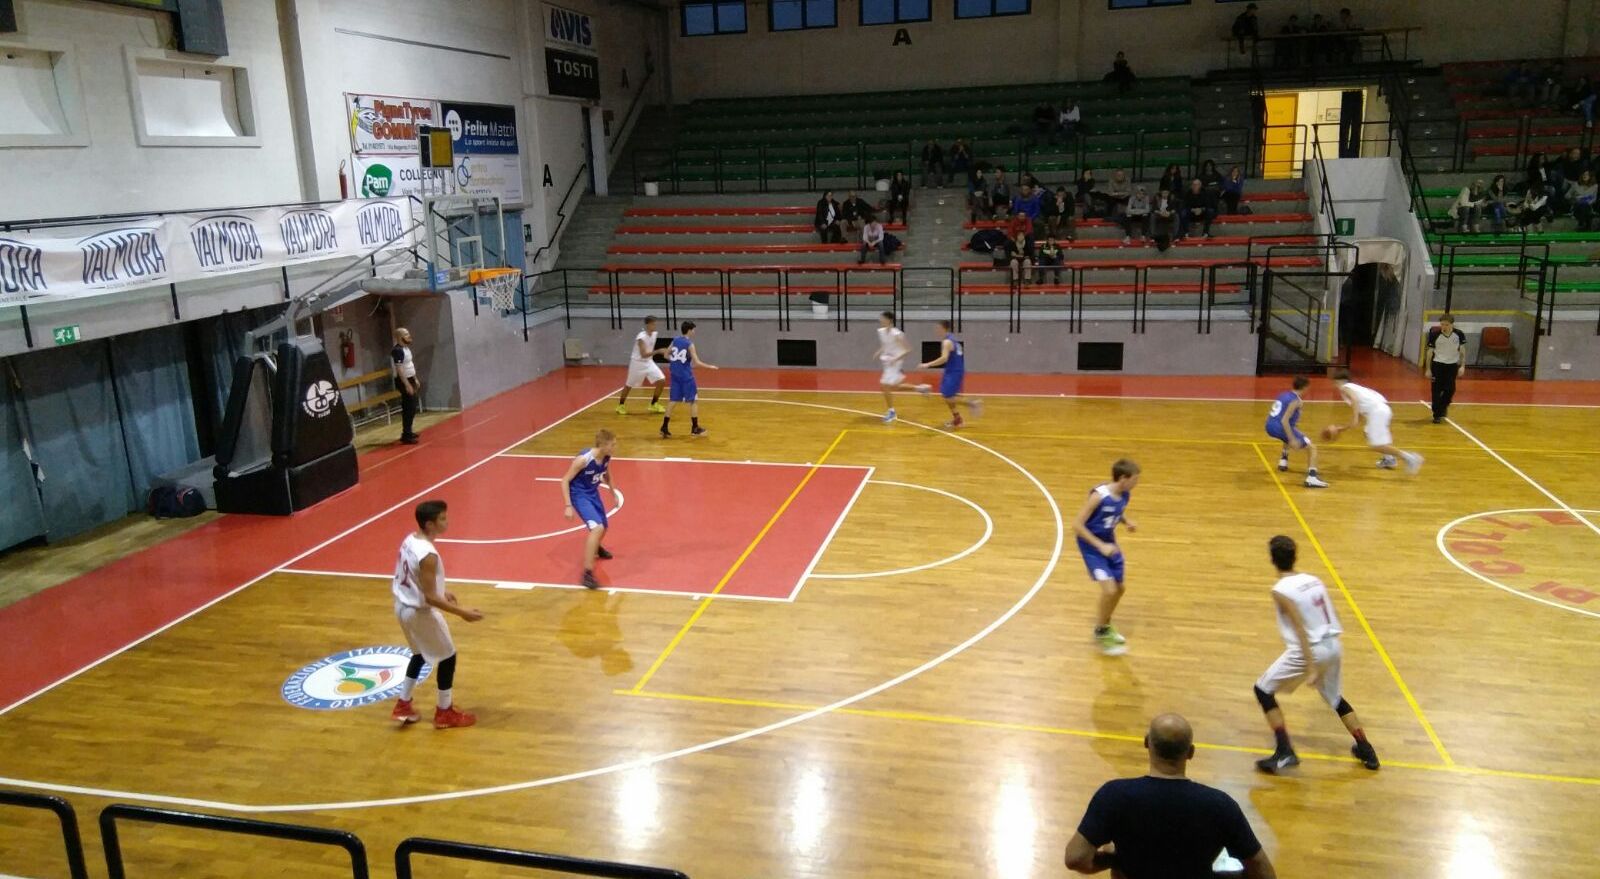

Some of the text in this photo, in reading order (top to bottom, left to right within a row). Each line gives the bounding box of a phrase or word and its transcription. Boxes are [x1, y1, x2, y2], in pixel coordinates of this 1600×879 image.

[551, 8, 592, 46] AVIS
[892, 28, 912, 46] A
[553, 58, 593, 79] TOSTI
[464, 120, 515, 137] Felix Match
[366, 174, 389, 189] Pam
[543, 164, 553, 188] A
[280, 212, 338, 255] VALMORA
[356, 206, 404, 245] VALMORA
[81, 232, 166, 284] VALMORA
[190, 221, 263, 267] VALMORA
[0, 244, 48, 294] ORA
[670, 347, 688, 364] 34
